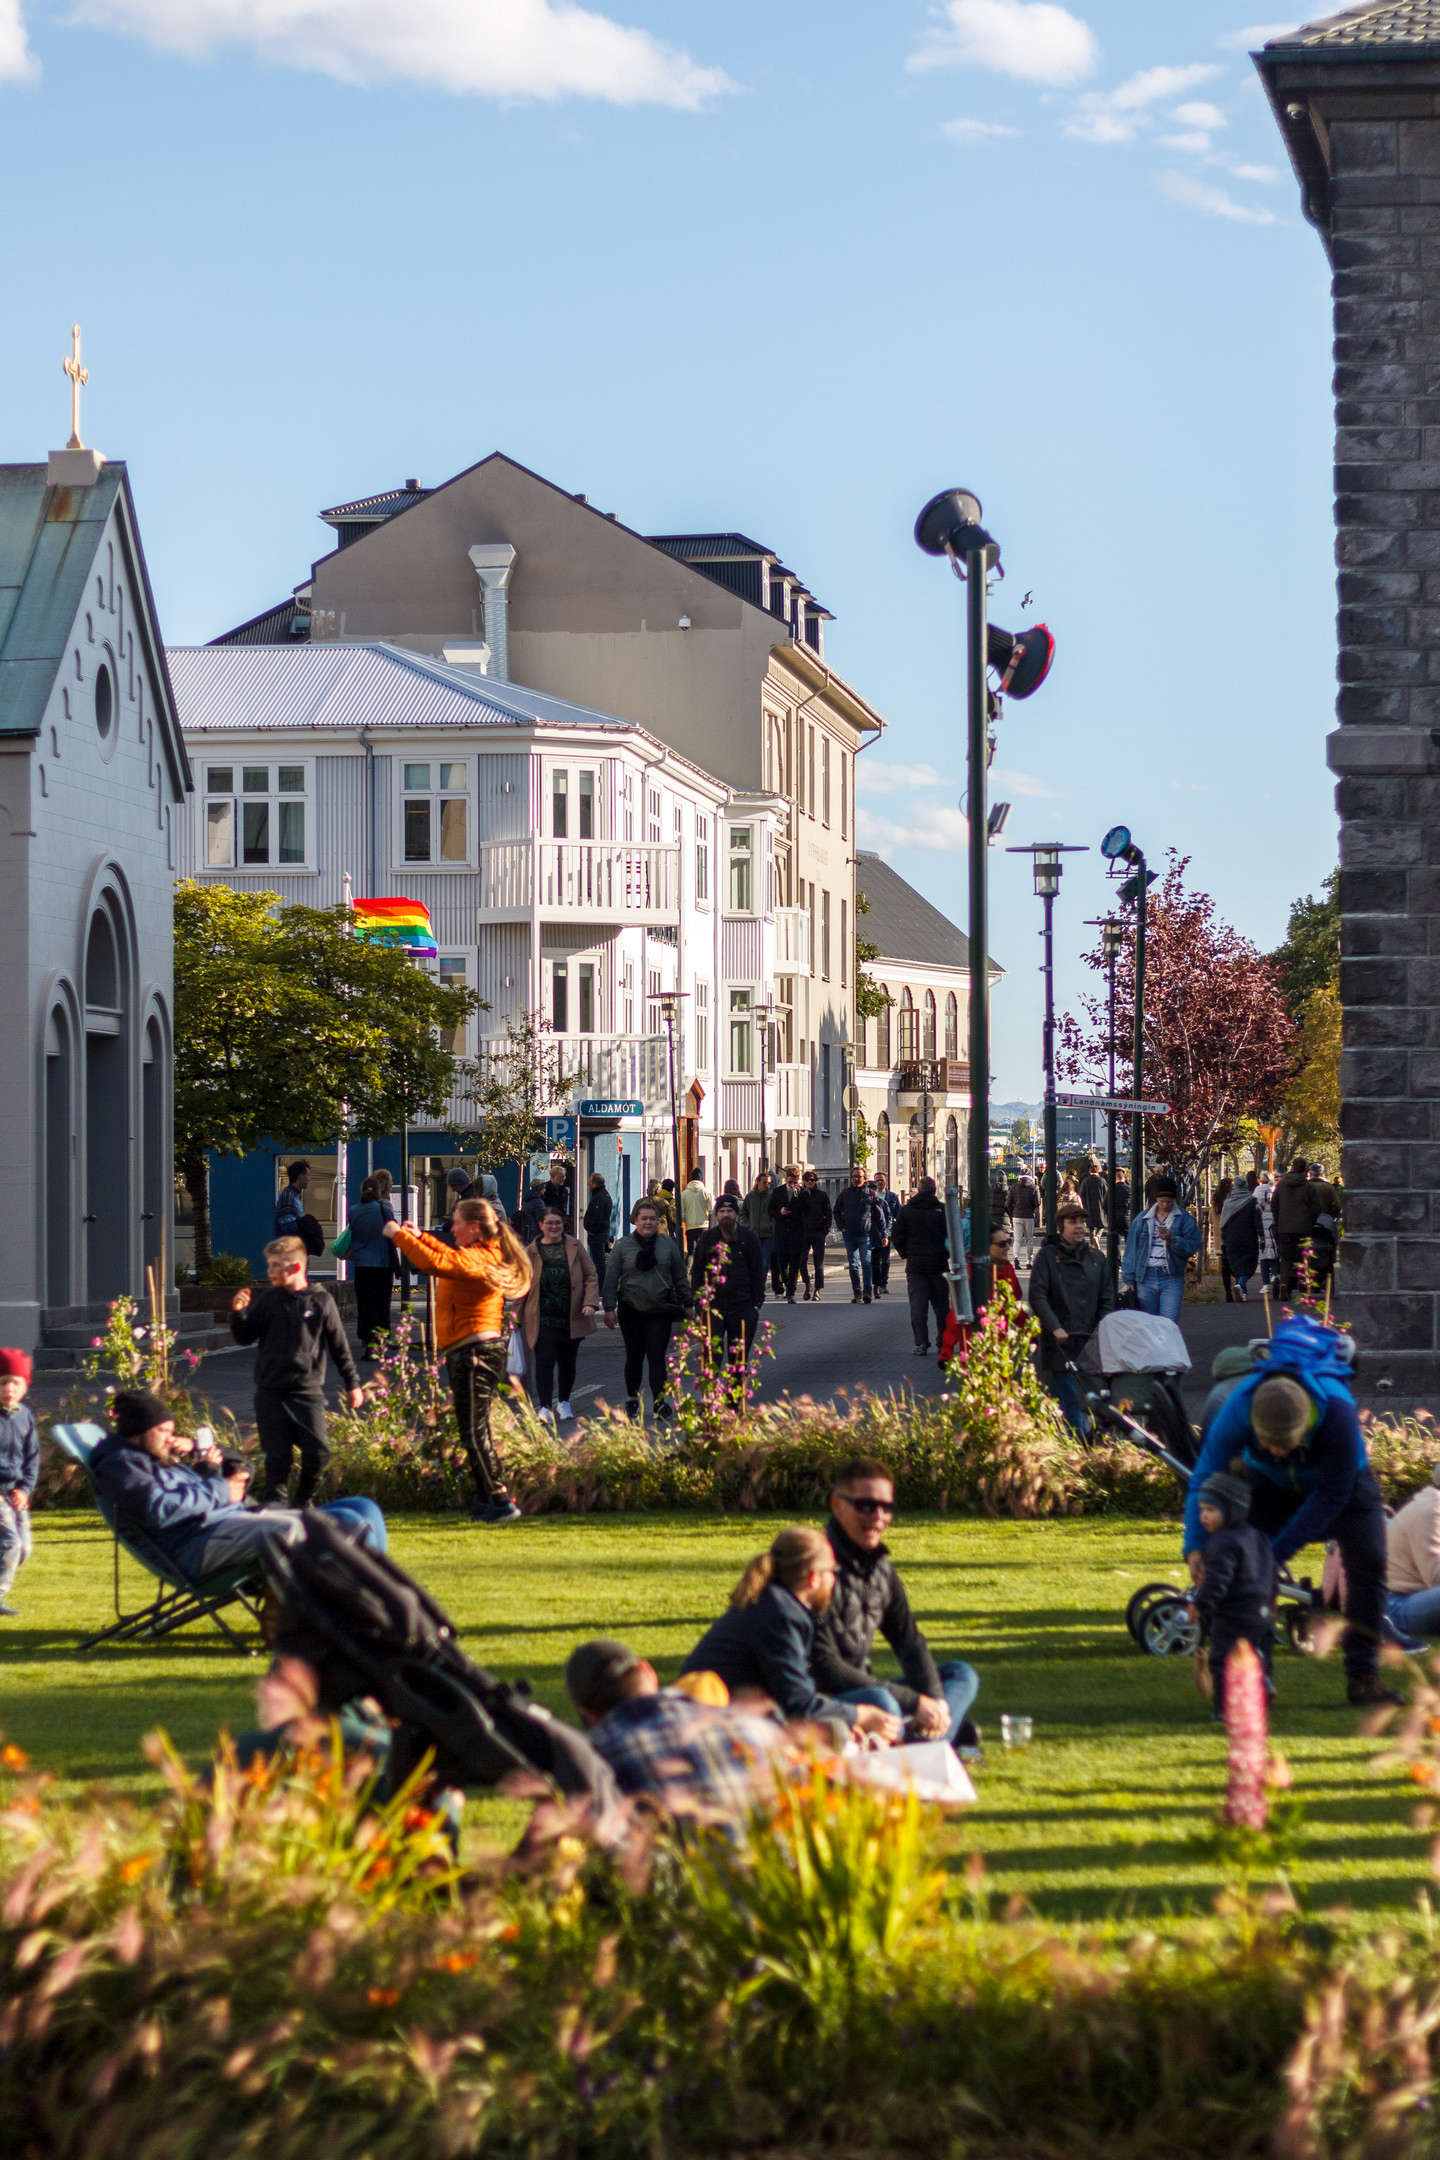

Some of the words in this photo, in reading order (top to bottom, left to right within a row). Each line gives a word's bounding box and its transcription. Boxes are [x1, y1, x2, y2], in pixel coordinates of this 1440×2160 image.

[588, 1103, 636, 1113] ALDAMÓT
[1073, 1097, 1156, 1111] Landnámssýningin
[552, 1119, 569, 1142] P
